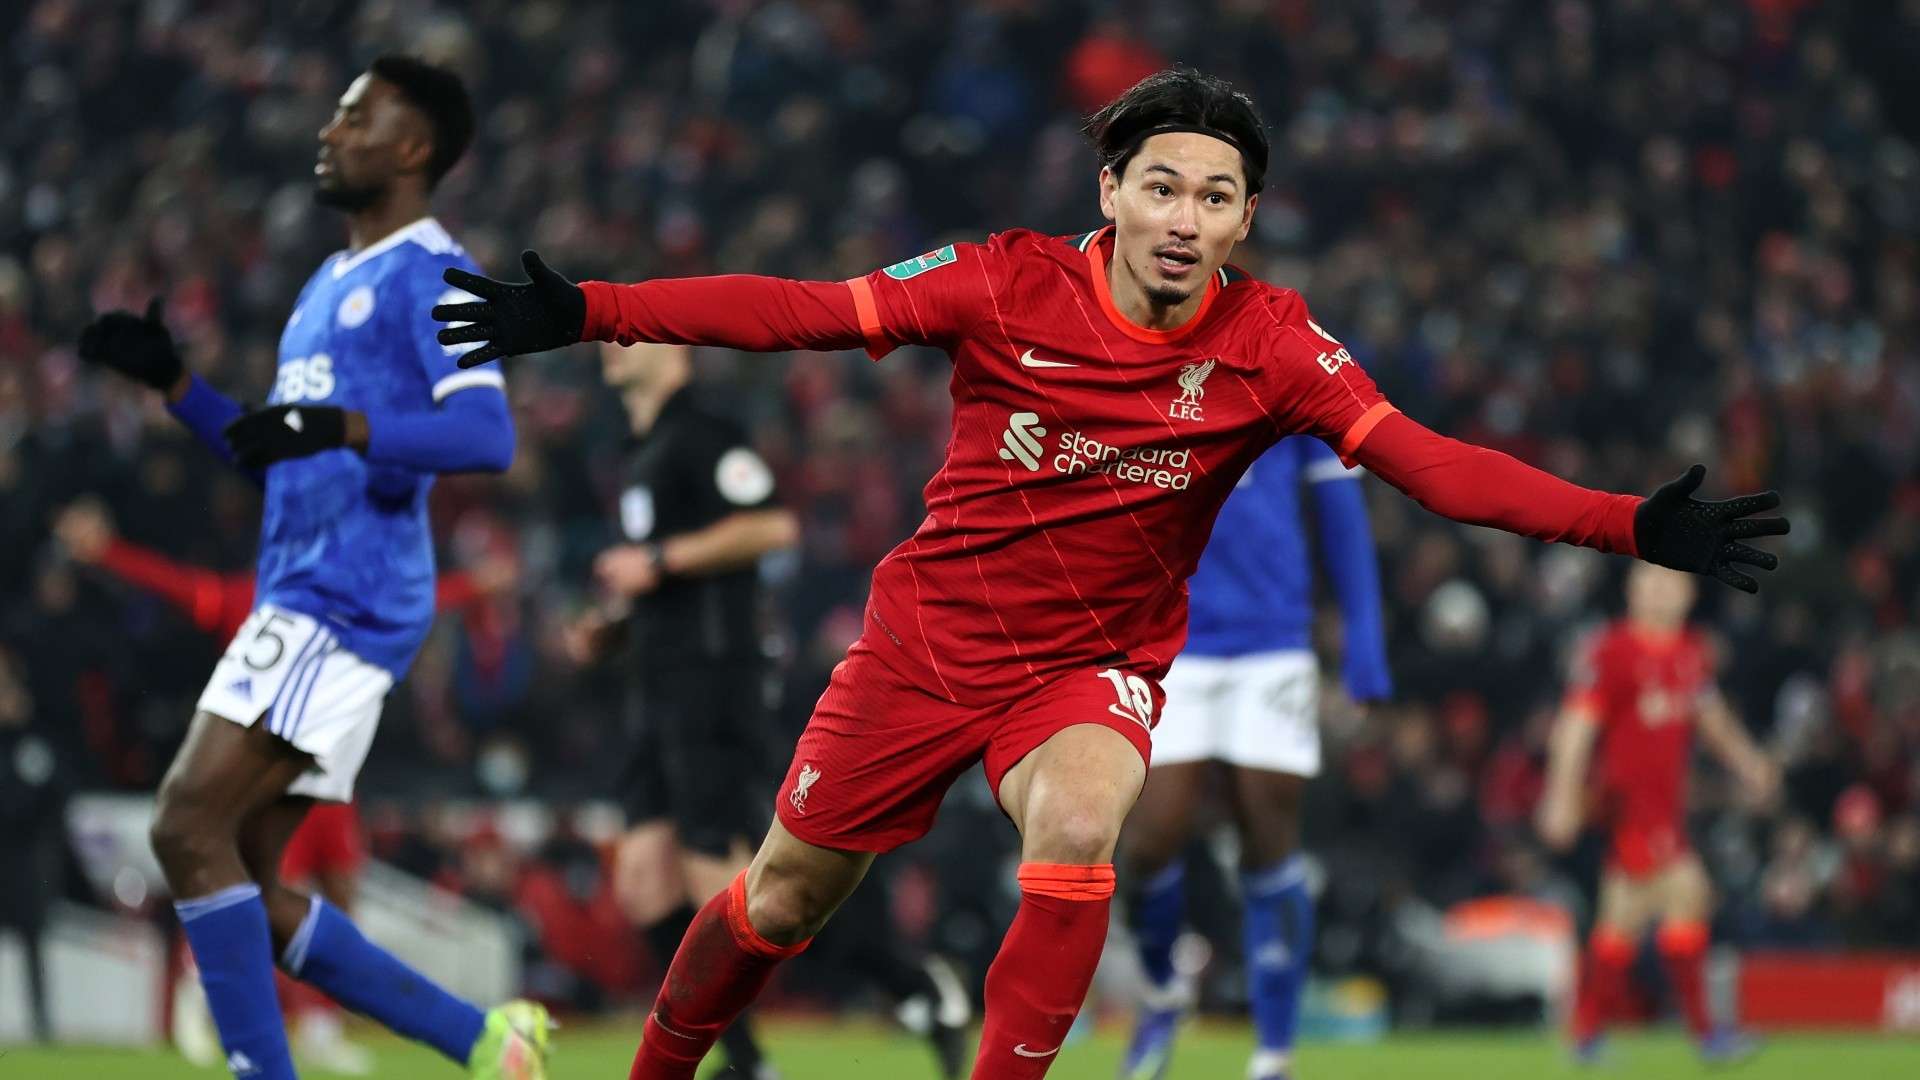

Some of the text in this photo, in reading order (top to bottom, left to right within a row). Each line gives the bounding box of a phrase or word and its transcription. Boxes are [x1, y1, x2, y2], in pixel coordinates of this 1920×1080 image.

[1168, 403, 1205, 422] L.F.C.
[1058, 431, 1190, 469] standard
[1053, 453, 1191, 490] chartered
